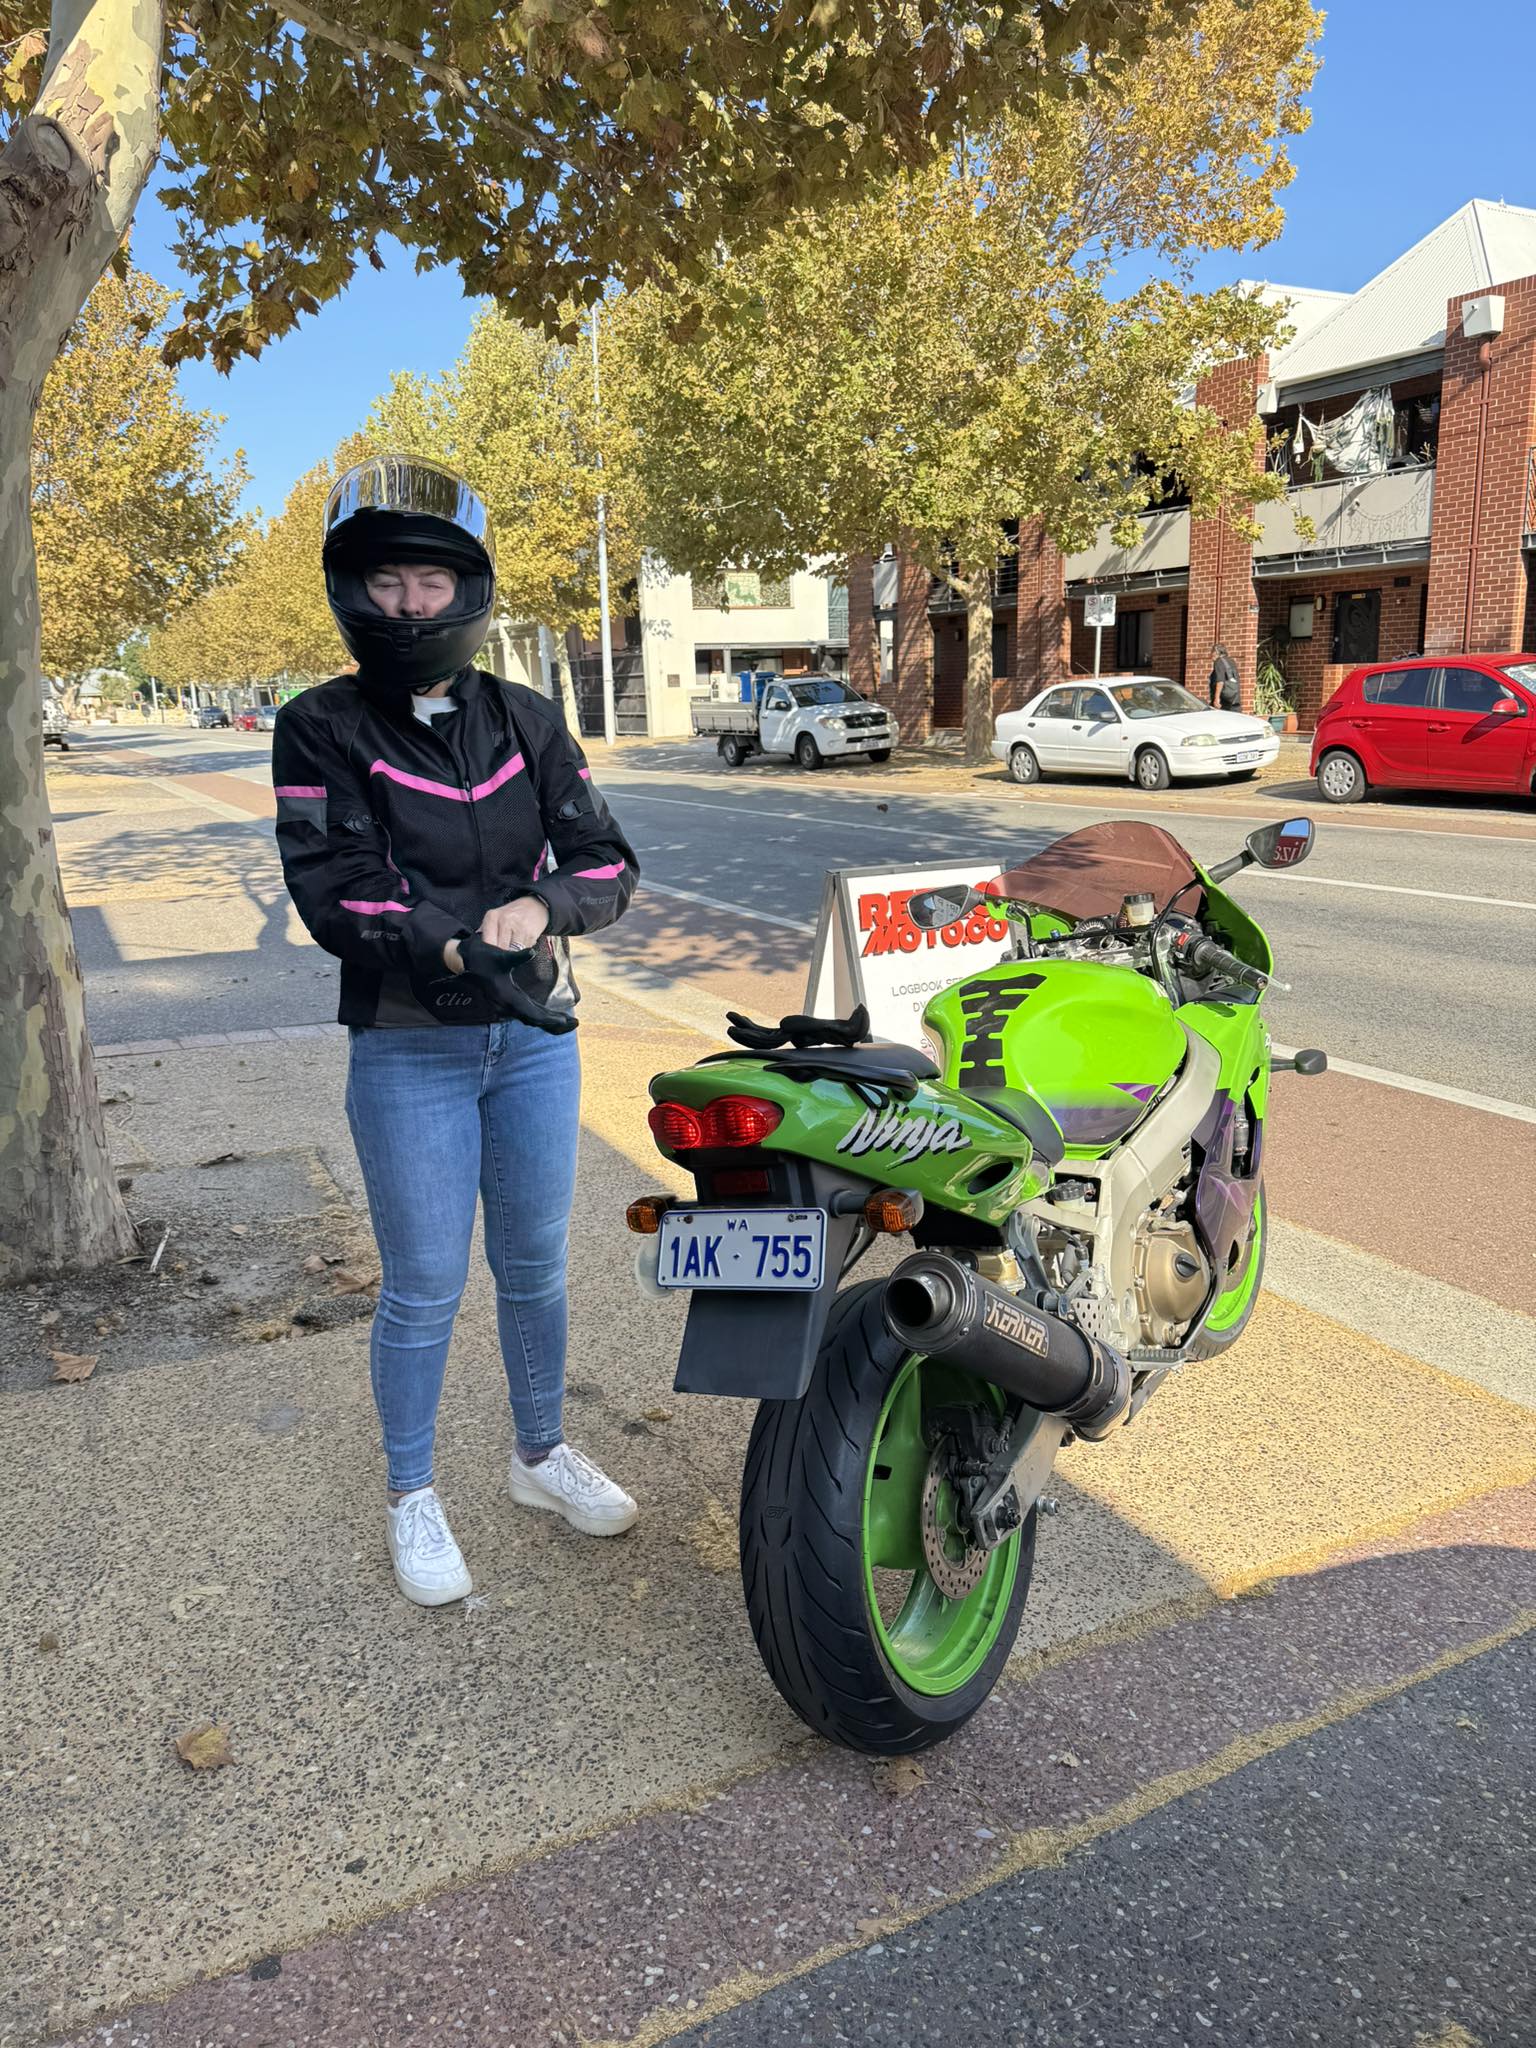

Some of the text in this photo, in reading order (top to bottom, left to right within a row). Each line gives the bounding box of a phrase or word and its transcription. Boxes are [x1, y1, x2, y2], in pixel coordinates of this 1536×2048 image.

[892, 979, 943, 997] LOGBOOK
[435, 992, 473, 1007] Clio
[836, 1099, 974, 1171] Ninja
[727, 1219, 748, 1231] WA
[671, 1235, 812, 1278] 1AK 755
